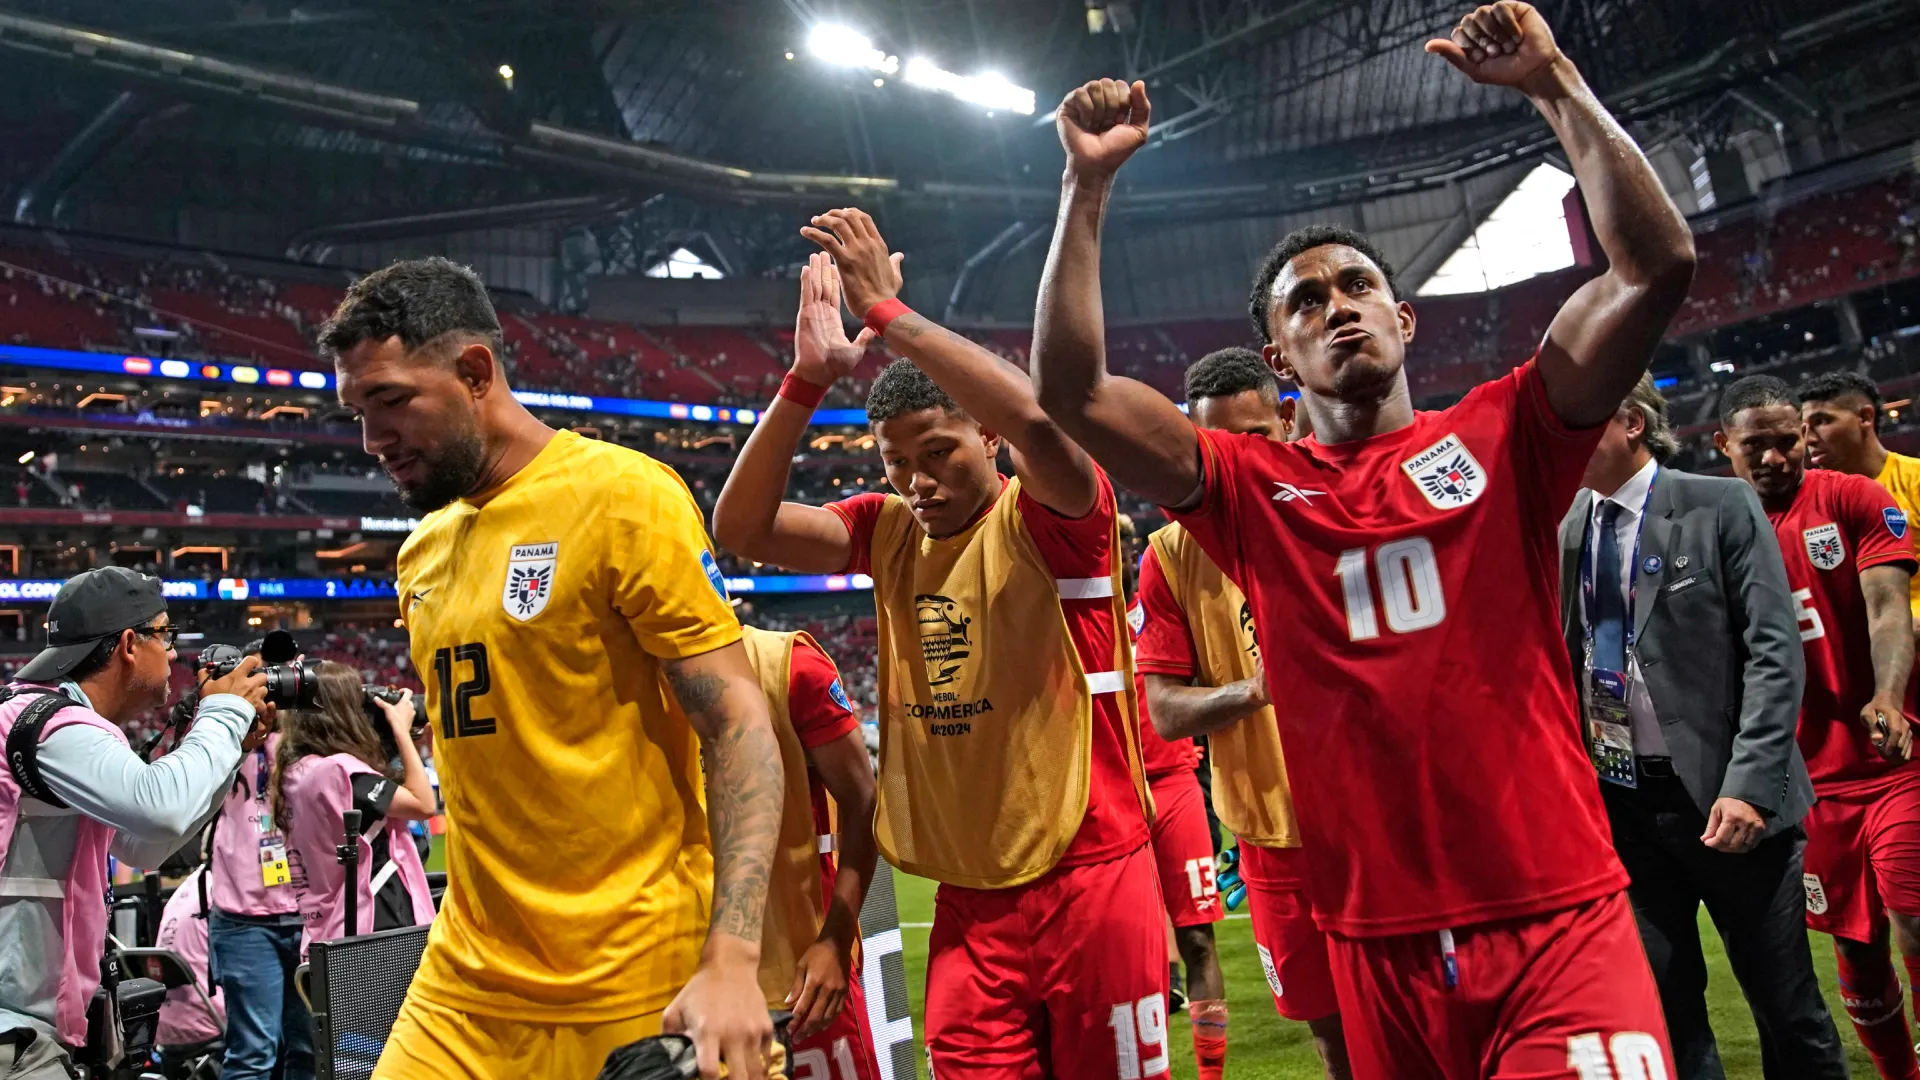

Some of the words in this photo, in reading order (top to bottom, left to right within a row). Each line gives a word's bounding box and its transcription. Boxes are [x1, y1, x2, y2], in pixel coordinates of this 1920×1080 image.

[1333, 535, 1447, 642] 10
[434, 642, 497, 739] 12
[13, 750, 38, 795] Canon
[1185, 856, 1218, 899] 13
[1109, 992, 1170, 1080] 19
